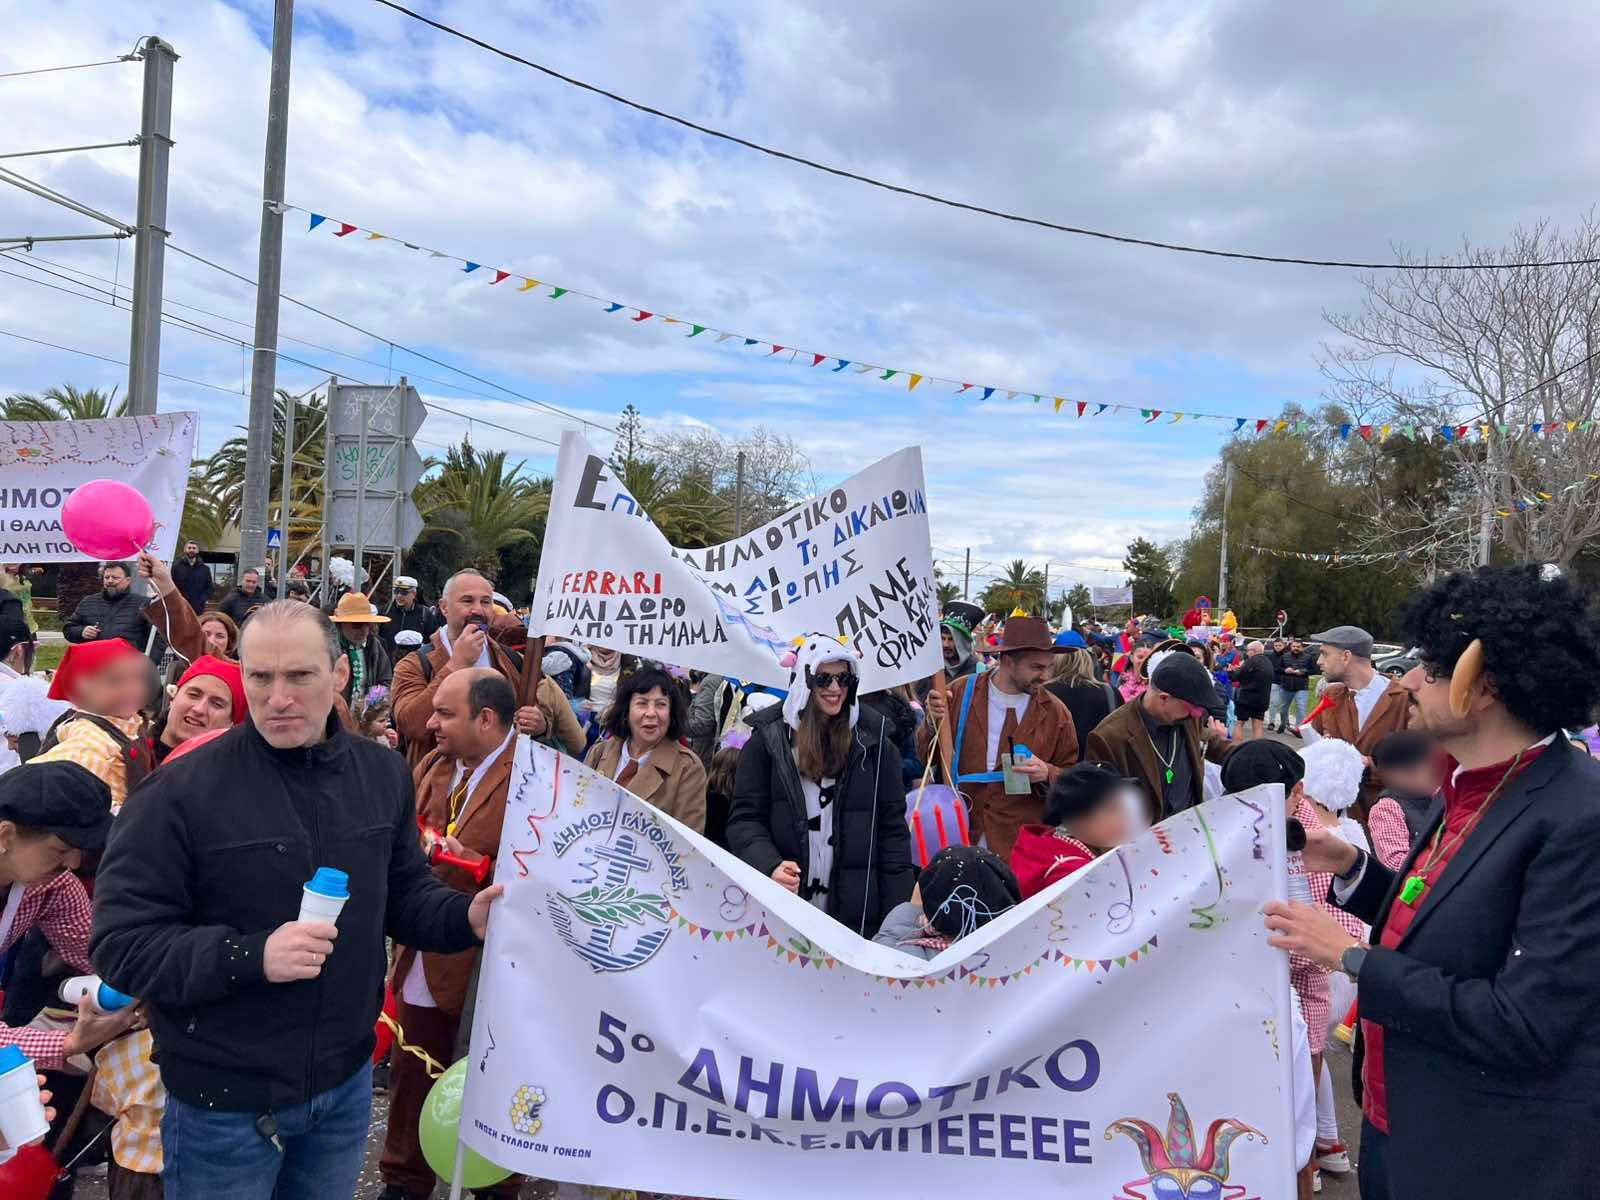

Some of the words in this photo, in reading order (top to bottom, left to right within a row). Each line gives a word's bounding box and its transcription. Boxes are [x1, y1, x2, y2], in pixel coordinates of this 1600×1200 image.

[834, 488, 926, 548] ΔΙΚΑΙΩΜΑ
[0, 542, 40, 554] ΛΛΗ
[562, 569, 662, 596] FERRARI
[744, 549, 863, 615] ΣΙΩΠΗΣ
[836, 557, 917, 637] ΠΑΜΕ
[546, 597, 608, 622] ΕΙΝΑΙ
[616, 598, 686, 621] ΔΩΡΟ
[570, 622, 613, 639] ΑΠΟ
[624, 624, 653, 645] ΤΗ
[658, 614, 729, 647] ΜΑΜΑ
[853, 618, 899, 659] ΓΙΑ
[552, 811, 613, 858] ΔΗΜΟΣ
[677, 1039, 1100, 1123] ΔΗΜΟΤΙΚΟ
[474, 1119, 498, 1139] ΕΝΩΣΗ
[501, 1134, 549, 1153] ΣΥΛΛΟΓΩΝ
[553, 1147, 592, 1159] ΓΟΝΕΩΝ
